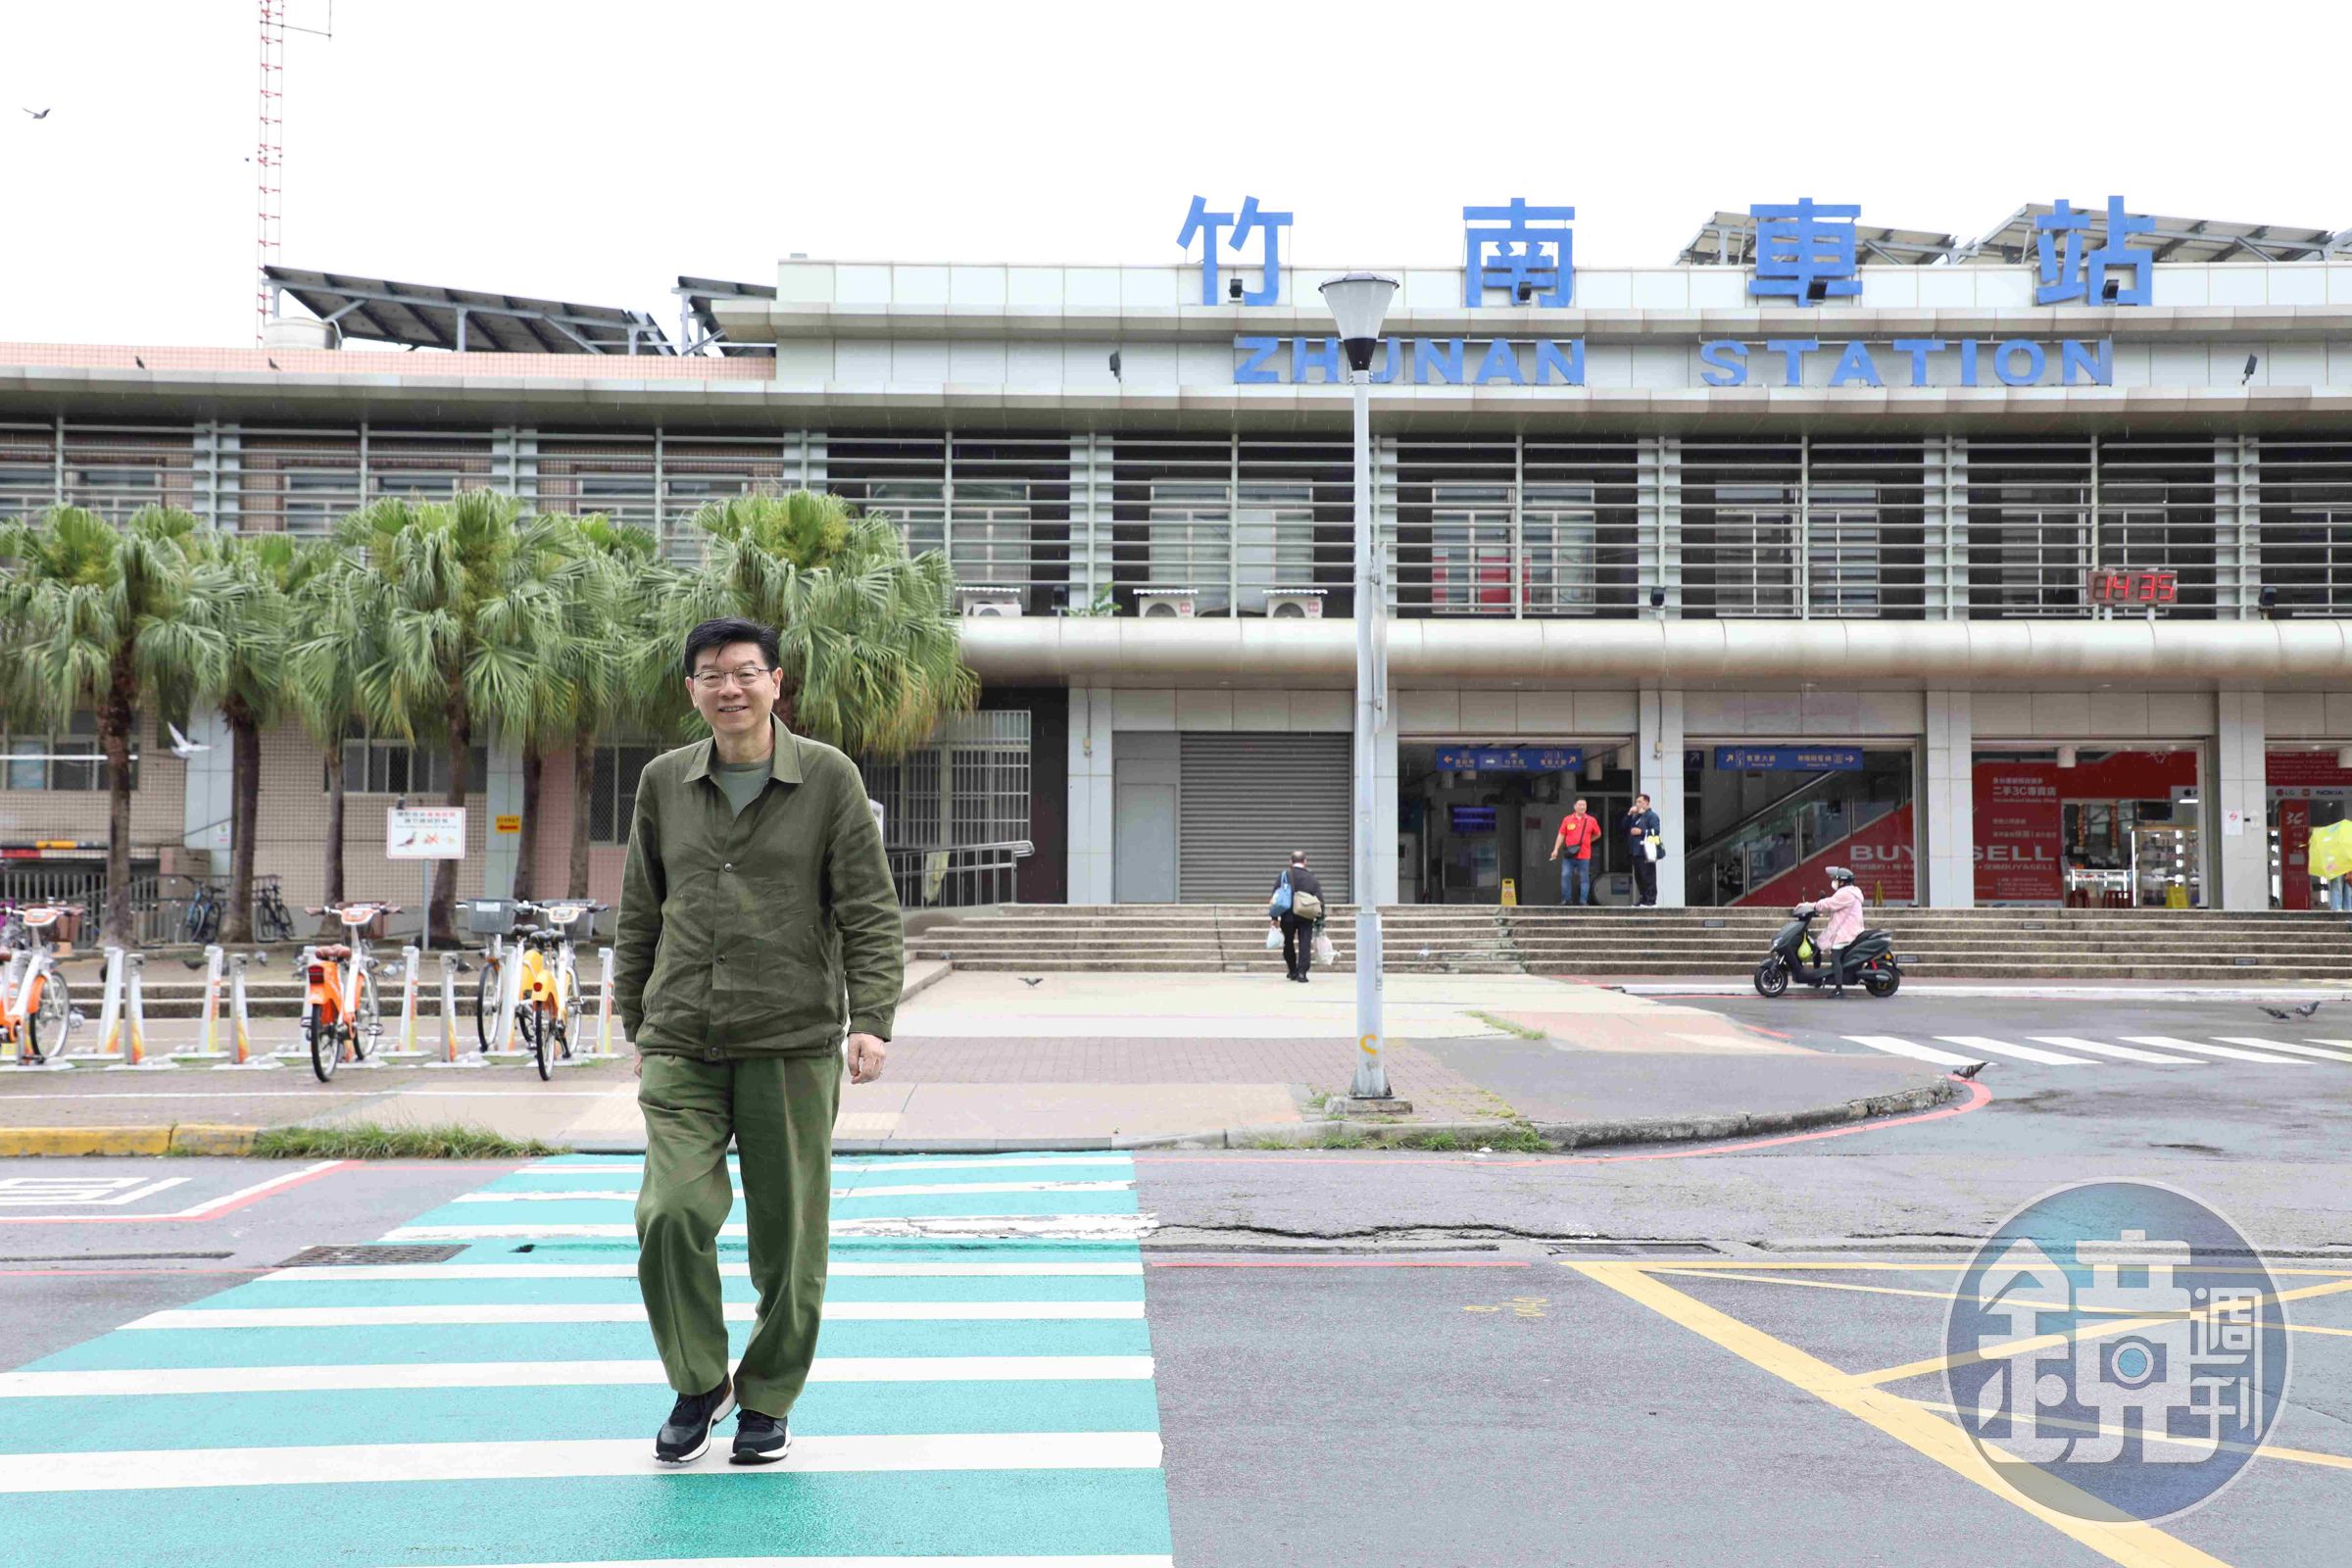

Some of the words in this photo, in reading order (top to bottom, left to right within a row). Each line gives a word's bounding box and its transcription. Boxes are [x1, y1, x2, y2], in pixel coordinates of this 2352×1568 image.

[1176, 195, 2155, 307] 竹南車站
[1234, 337, 1585, 384] ZHUNAN
[1701, 339, 2113, 386] STATION
[1974, 845, 2055, 861] SELL
